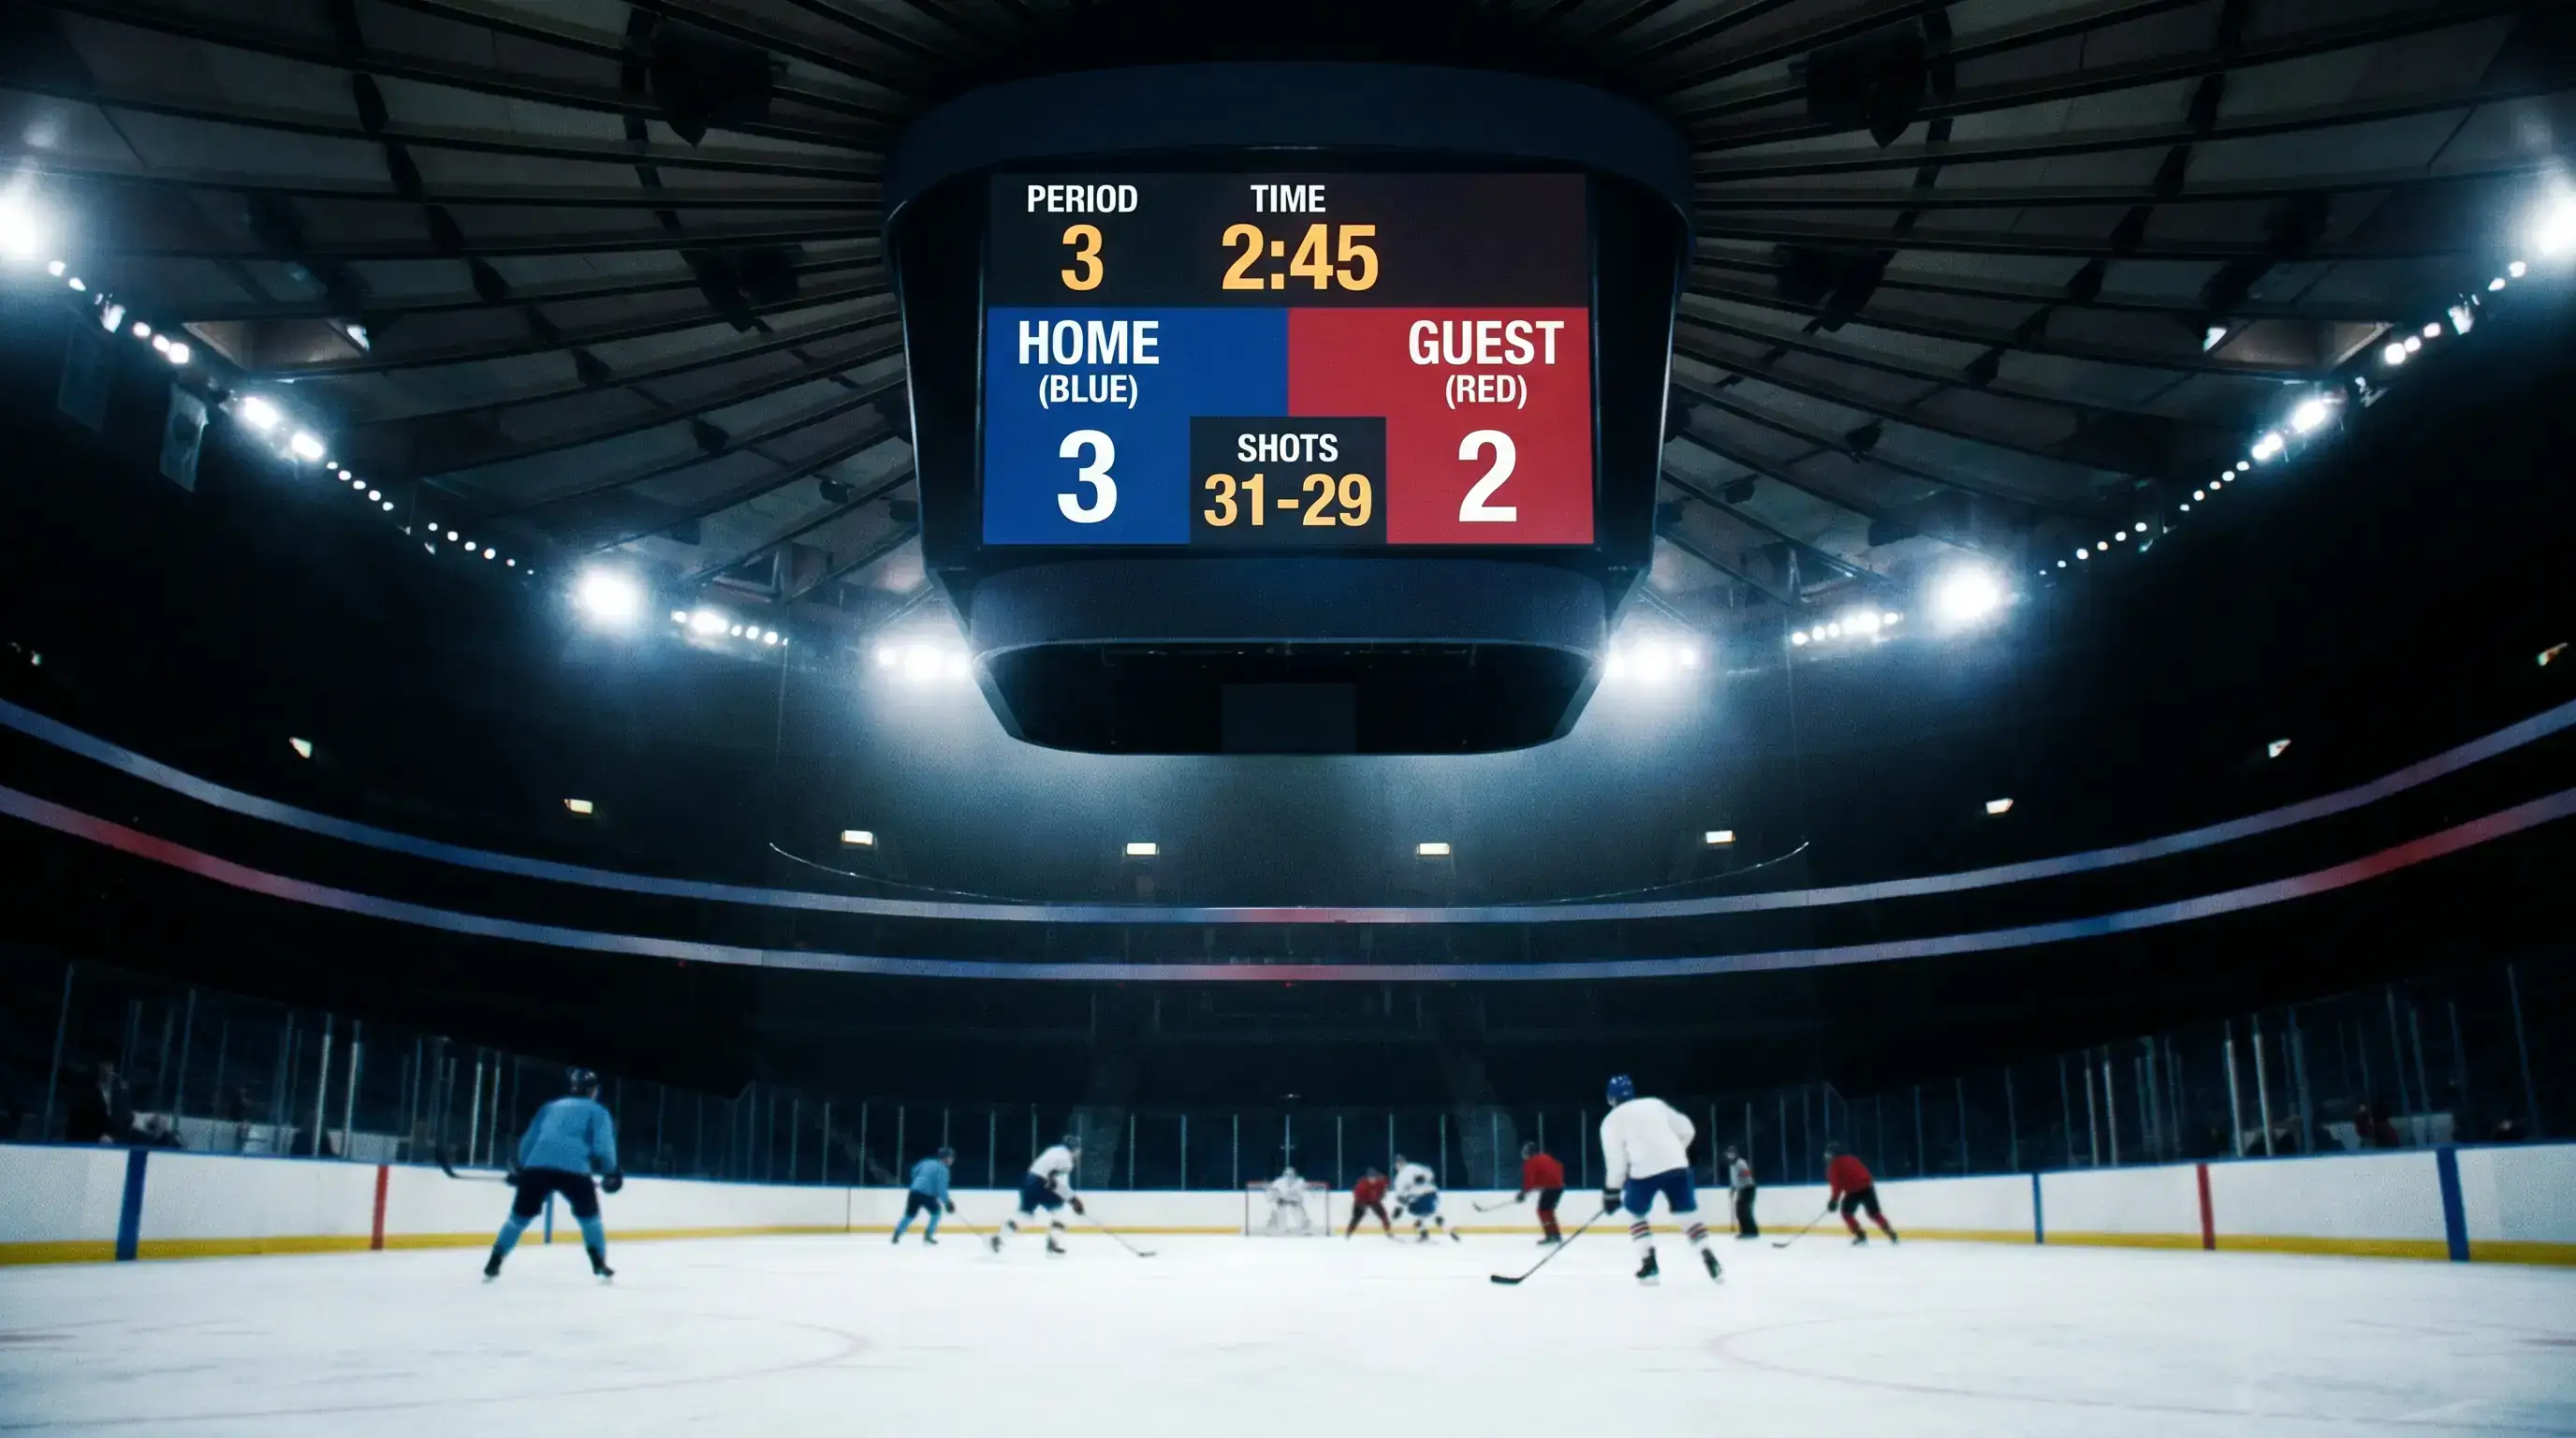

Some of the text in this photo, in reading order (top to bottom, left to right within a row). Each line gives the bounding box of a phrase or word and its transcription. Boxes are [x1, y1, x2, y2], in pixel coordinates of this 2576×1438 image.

[1027, 184, 1138, 213] PERIOD
[1251, 184, 1326, 213] TIME
[1061, 224, 1104, 291] 3
[1222, 224, 1379, 291] 2:45
[1018, 319, 1160, 365] HOME
[1409, 319, 1564, 366] GUEST
[1039, 374, 1138, 409] (BLUE)
[1445, 374, 1528, 410] (RED)
[1237, 433, 1339, 462] SHOTS
[1057, 429, 1118, 523] 3
[1457, 429, 1517, 522] 2
[1204, 473, 1373, 527] 31-29
